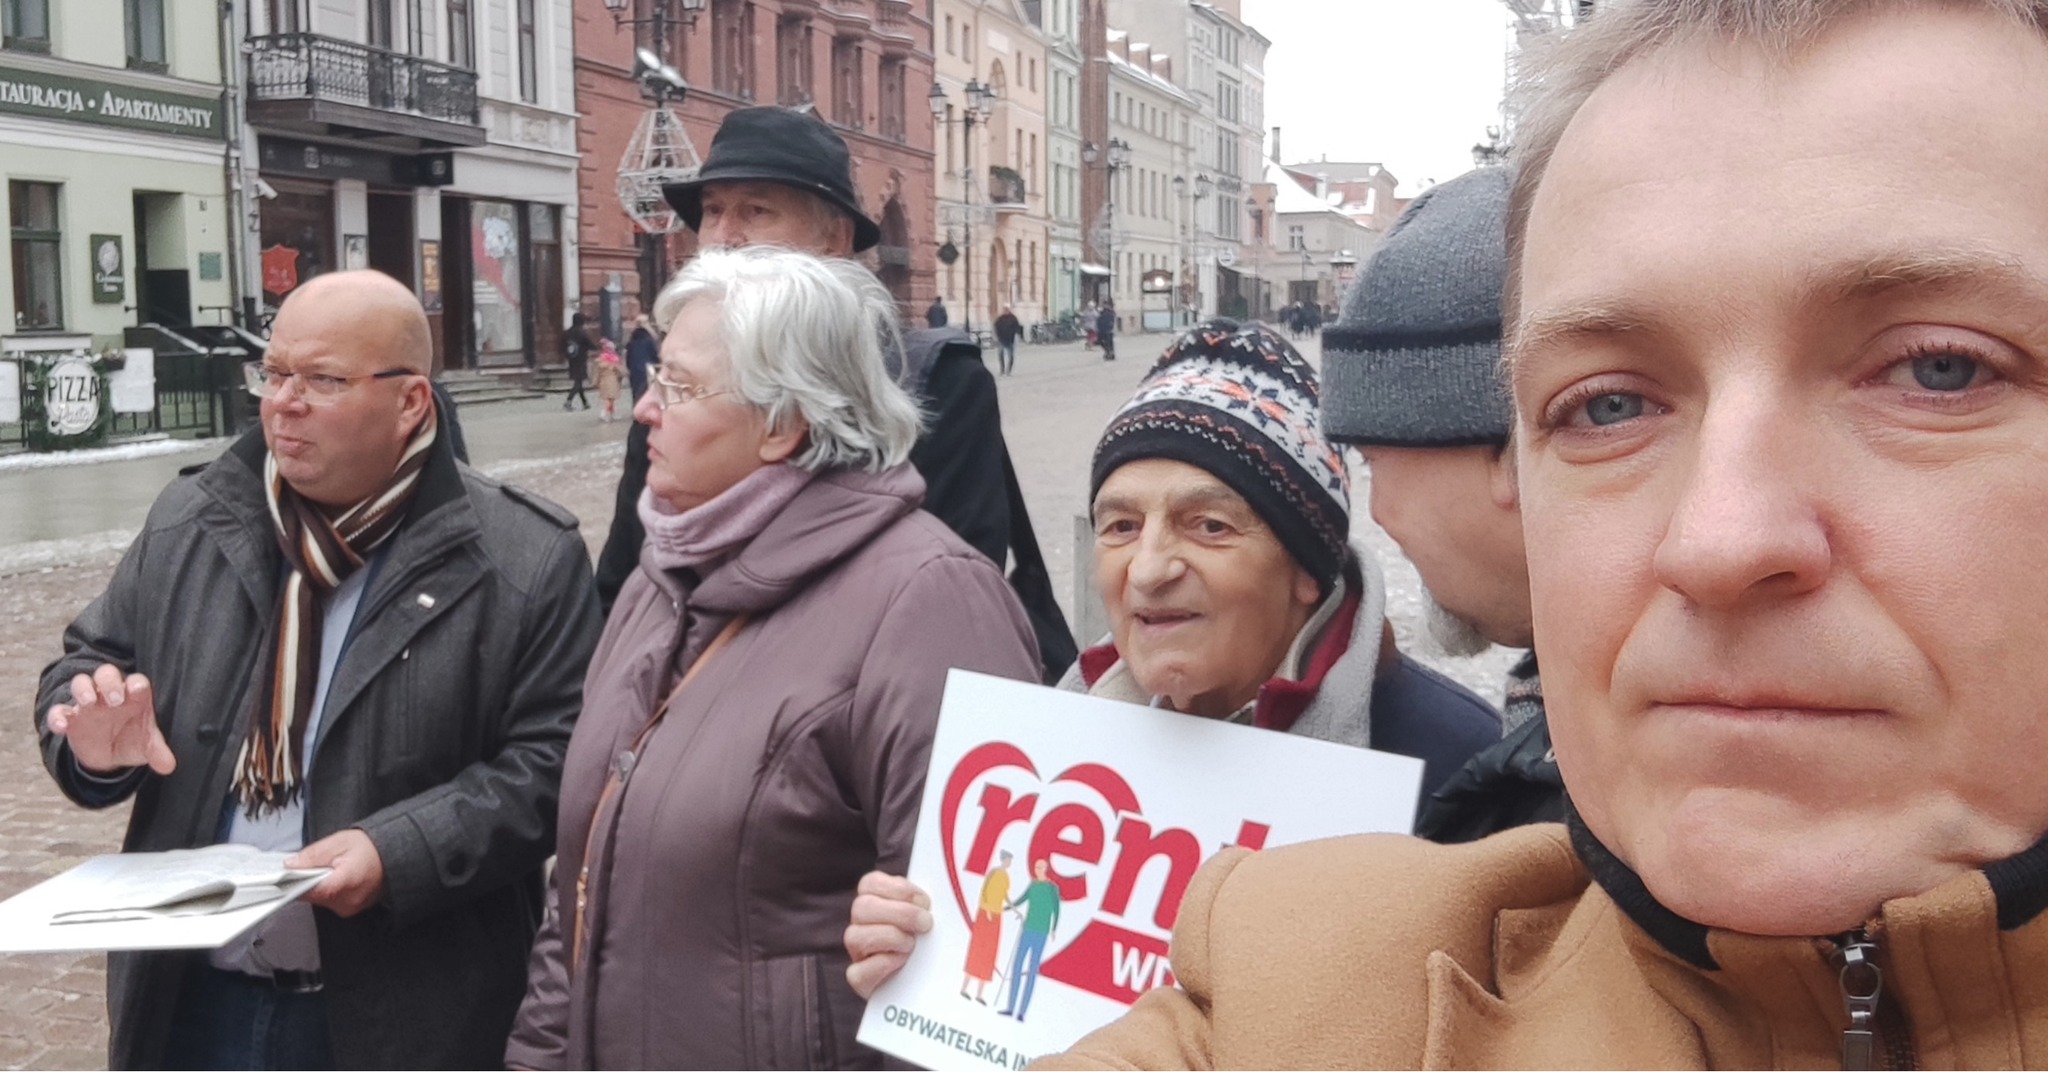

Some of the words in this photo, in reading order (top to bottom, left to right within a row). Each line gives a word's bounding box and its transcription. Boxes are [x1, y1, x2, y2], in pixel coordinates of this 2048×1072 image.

[100, 91, 212, 128] APARTAMENTY
[47, 374, 101, 404] PIZZA
[883, 1004, 1007, 1068] OBYWATELSKA
